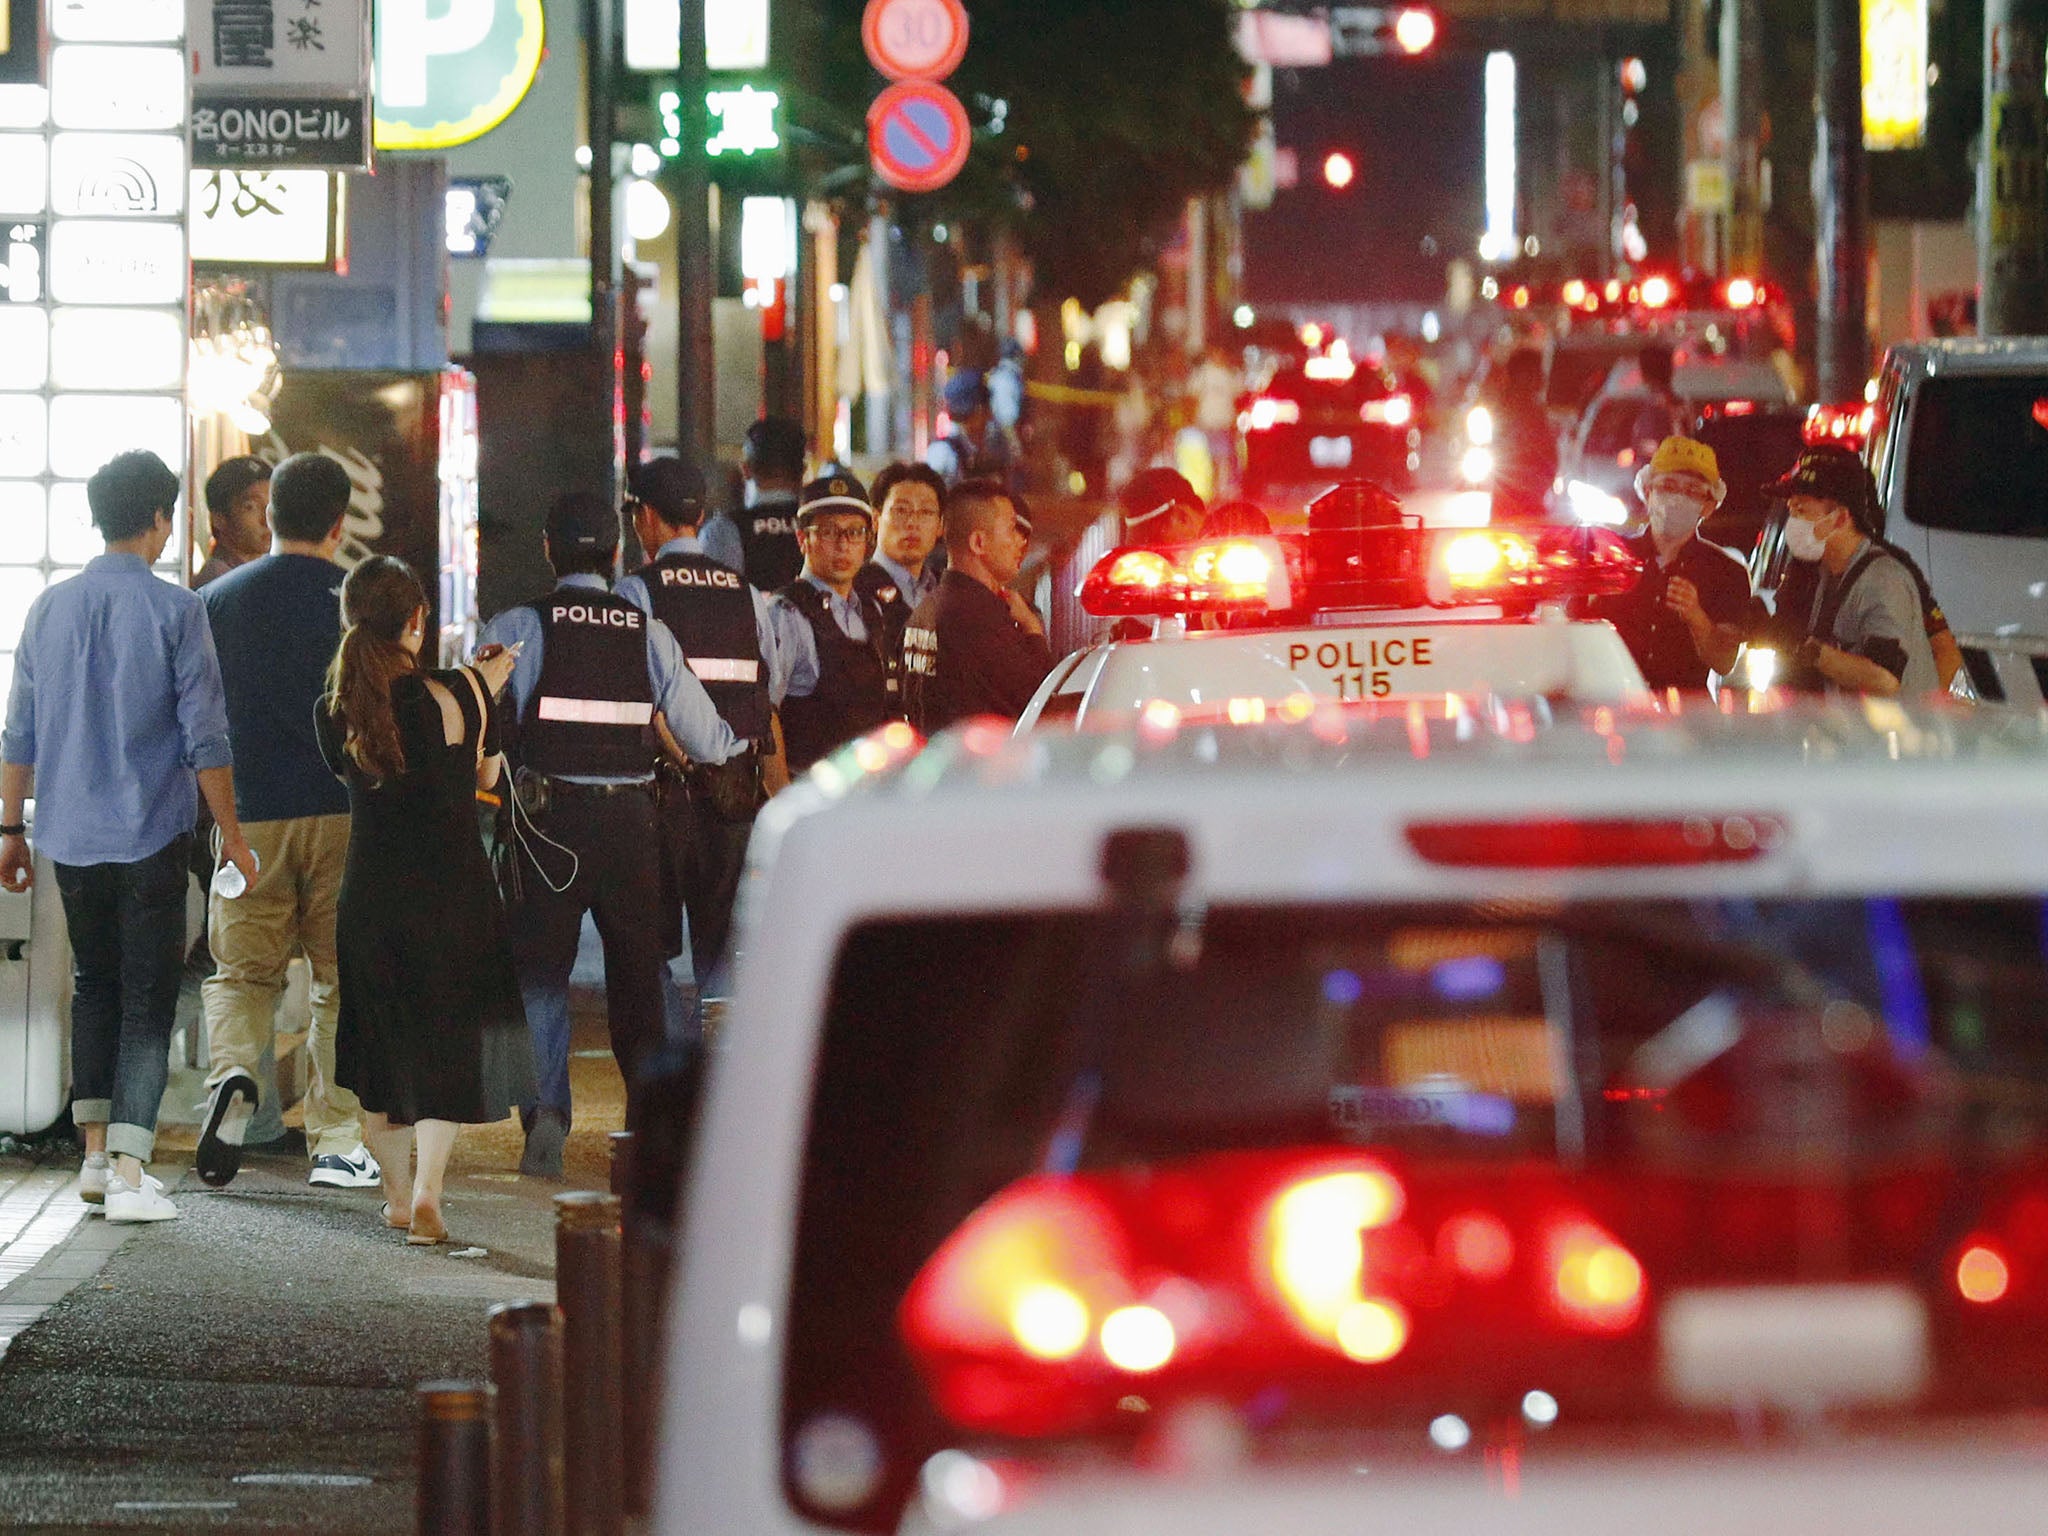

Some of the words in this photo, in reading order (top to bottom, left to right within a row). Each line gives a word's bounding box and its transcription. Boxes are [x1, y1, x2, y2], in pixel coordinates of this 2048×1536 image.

[891, 8, 943, 49] 30
[660, 568, 740, 588] POLICE
[552, 605, 640, 628] POLICE
[1289, 638, 1433, 671] POLICE
[1332, 671, 1391, 699] 115
